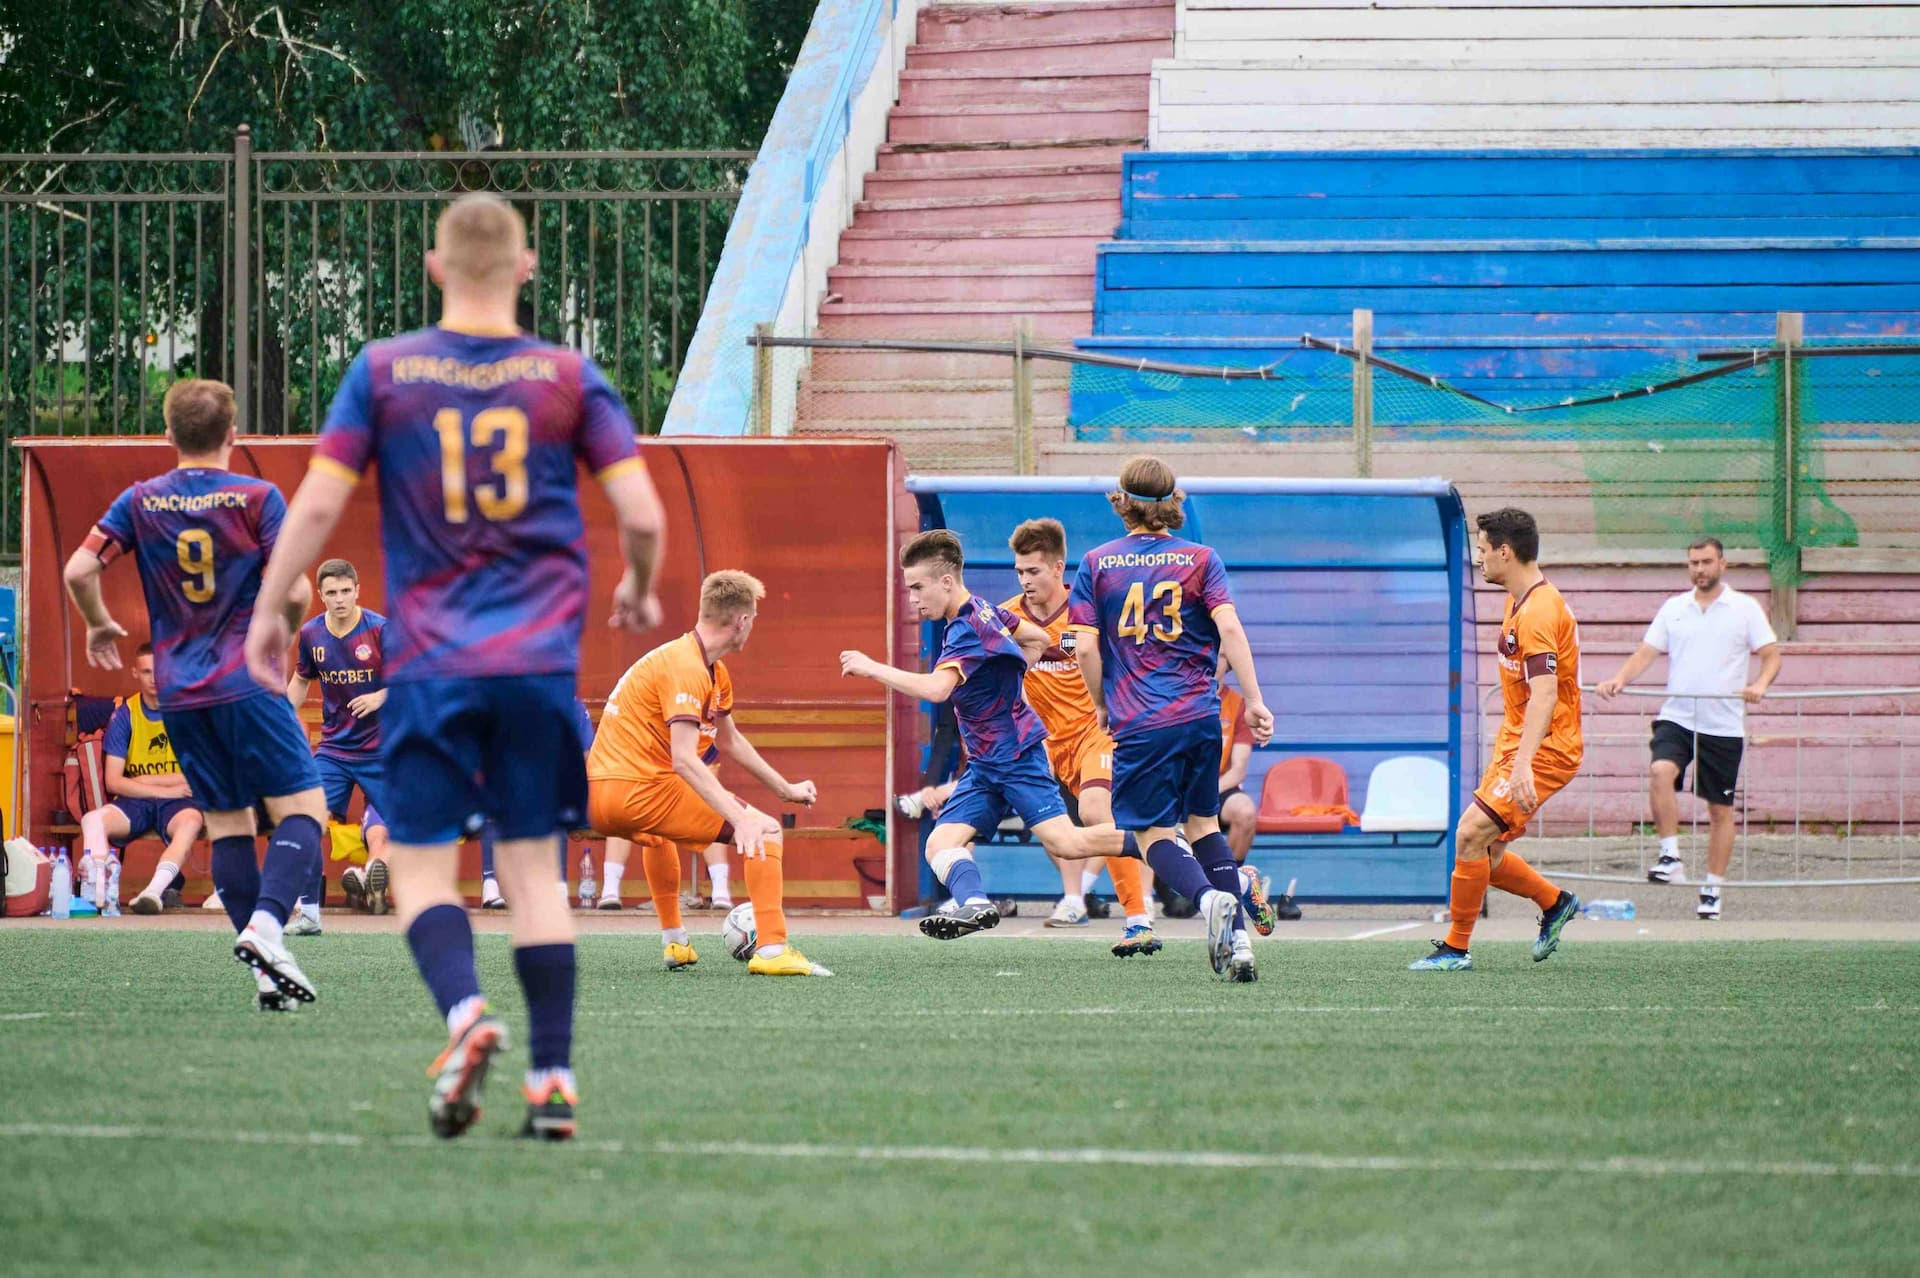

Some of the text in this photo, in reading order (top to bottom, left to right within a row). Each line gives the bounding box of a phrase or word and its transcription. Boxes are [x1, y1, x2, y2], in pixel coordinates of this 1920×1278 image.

[433, 405, 529, 524] 13
[176, 528, 216, 603] 9
[1098, 553, 1195, 570] КРАСНОЯРСК
[1118, 580, 1183, 645] 43
[312, 646, 325, 663] 10
[1100, 752, 1111, 769] 11
